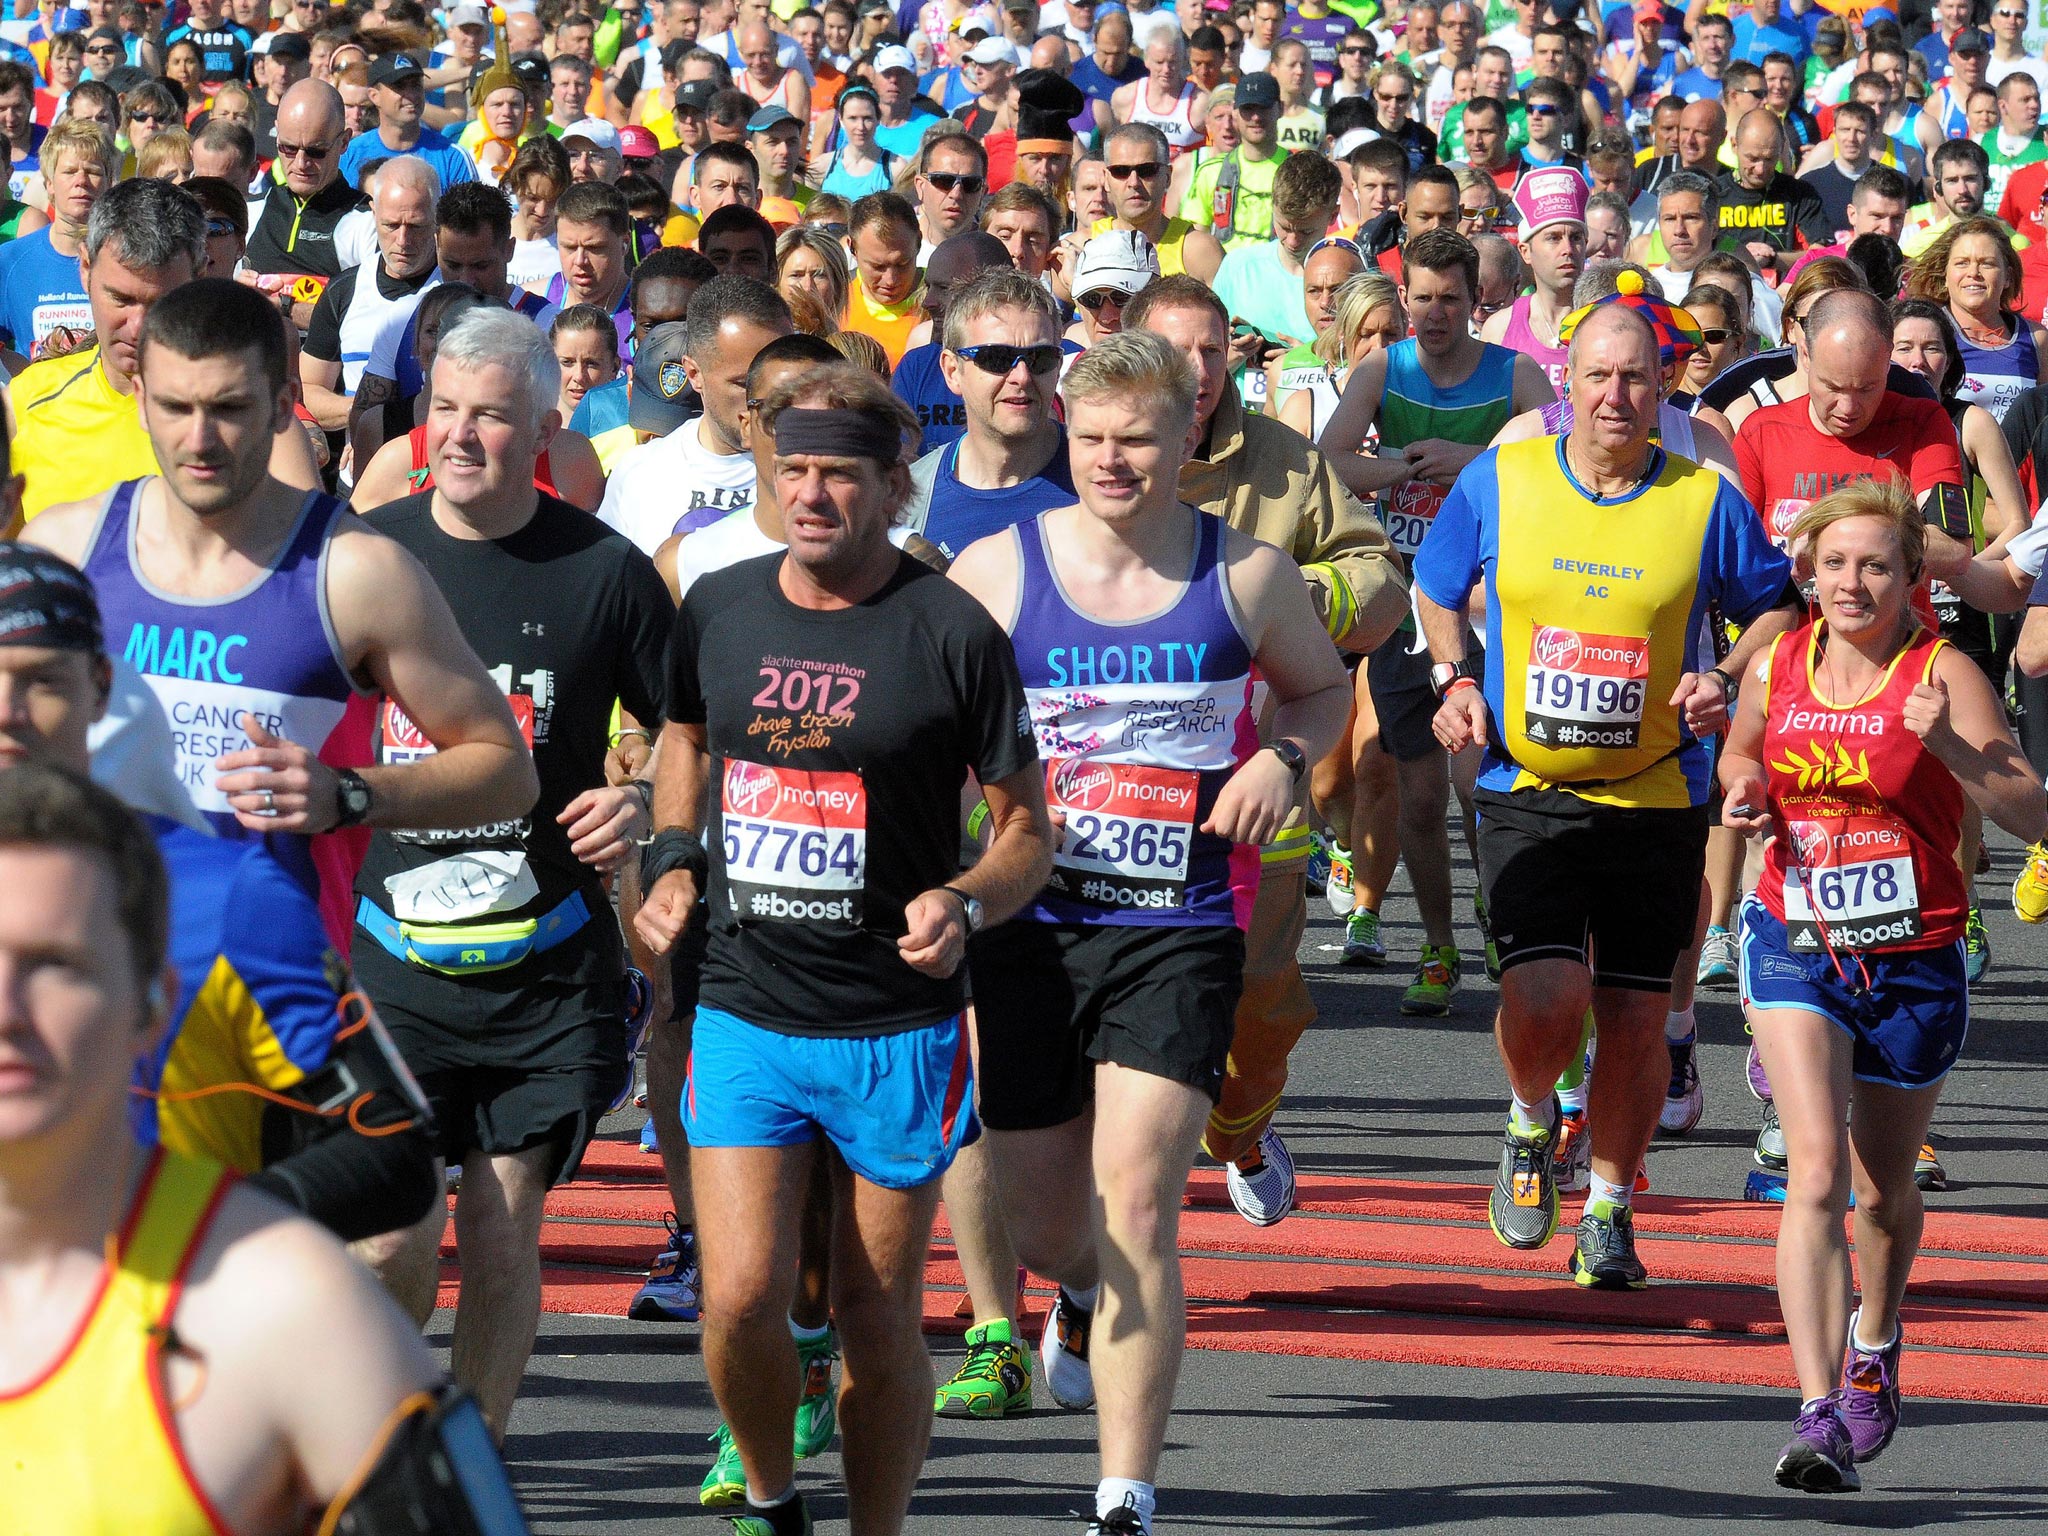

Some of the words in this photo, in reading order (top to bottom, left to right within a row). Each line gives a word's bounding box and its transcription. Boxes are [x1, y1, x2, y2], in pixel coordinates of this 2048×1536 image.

[1718, 203, 1786, 228] ROWIE
[38, 291, 66, 303] Holland
[39, 309, 87, 319] RUNNING
[39, 322, 55, 331] THE
[1993, 395, 2016, 408] RES
[917, 404, 968, 427] GRE
[1396, 480, 1431, 513] Virgin
[1389, 514, 1433, 547] 20
[1552, 557, 1645, 581] BEVERLEY
[1584, 584, 1609, 599] AC
[123, 622, 248, 685] MARC
[1538, 626, 1580, 667] Virgin
[1584, 644, 1644, 668] money
[760, 654, 867, 679] slachtemarathon
[1047, 642, 1208, 688] SHORTY
[546, 671, 555, 697] 2011
[752, 667, 861, 720] 2012
[1531, 670, 1643, 715] 19196
[1128, 697, 1217, 714] CANCER
[747, 713, 793, 736] drave
[800, 707, 854, 728] troch
[1124, 710, 1227, 734] RESEARCH
[1777, 702, 1885, 736] jemma
[766, 728, 832, 759] Fryslân
[1120, 732, 1148, 750] UK
[730, 760, 777, 814] Virgin
[783, 785, 860, 815] money
[1056, 758, 1111, 807] Virgin
[1117, 781, 1193, 809] money
[724, 818, 860, 878] 57764
[1833, 828, 1902, 848] money
[1177, 867, 1184, 877] 5
[1909, 897, 1915, 906] 5
